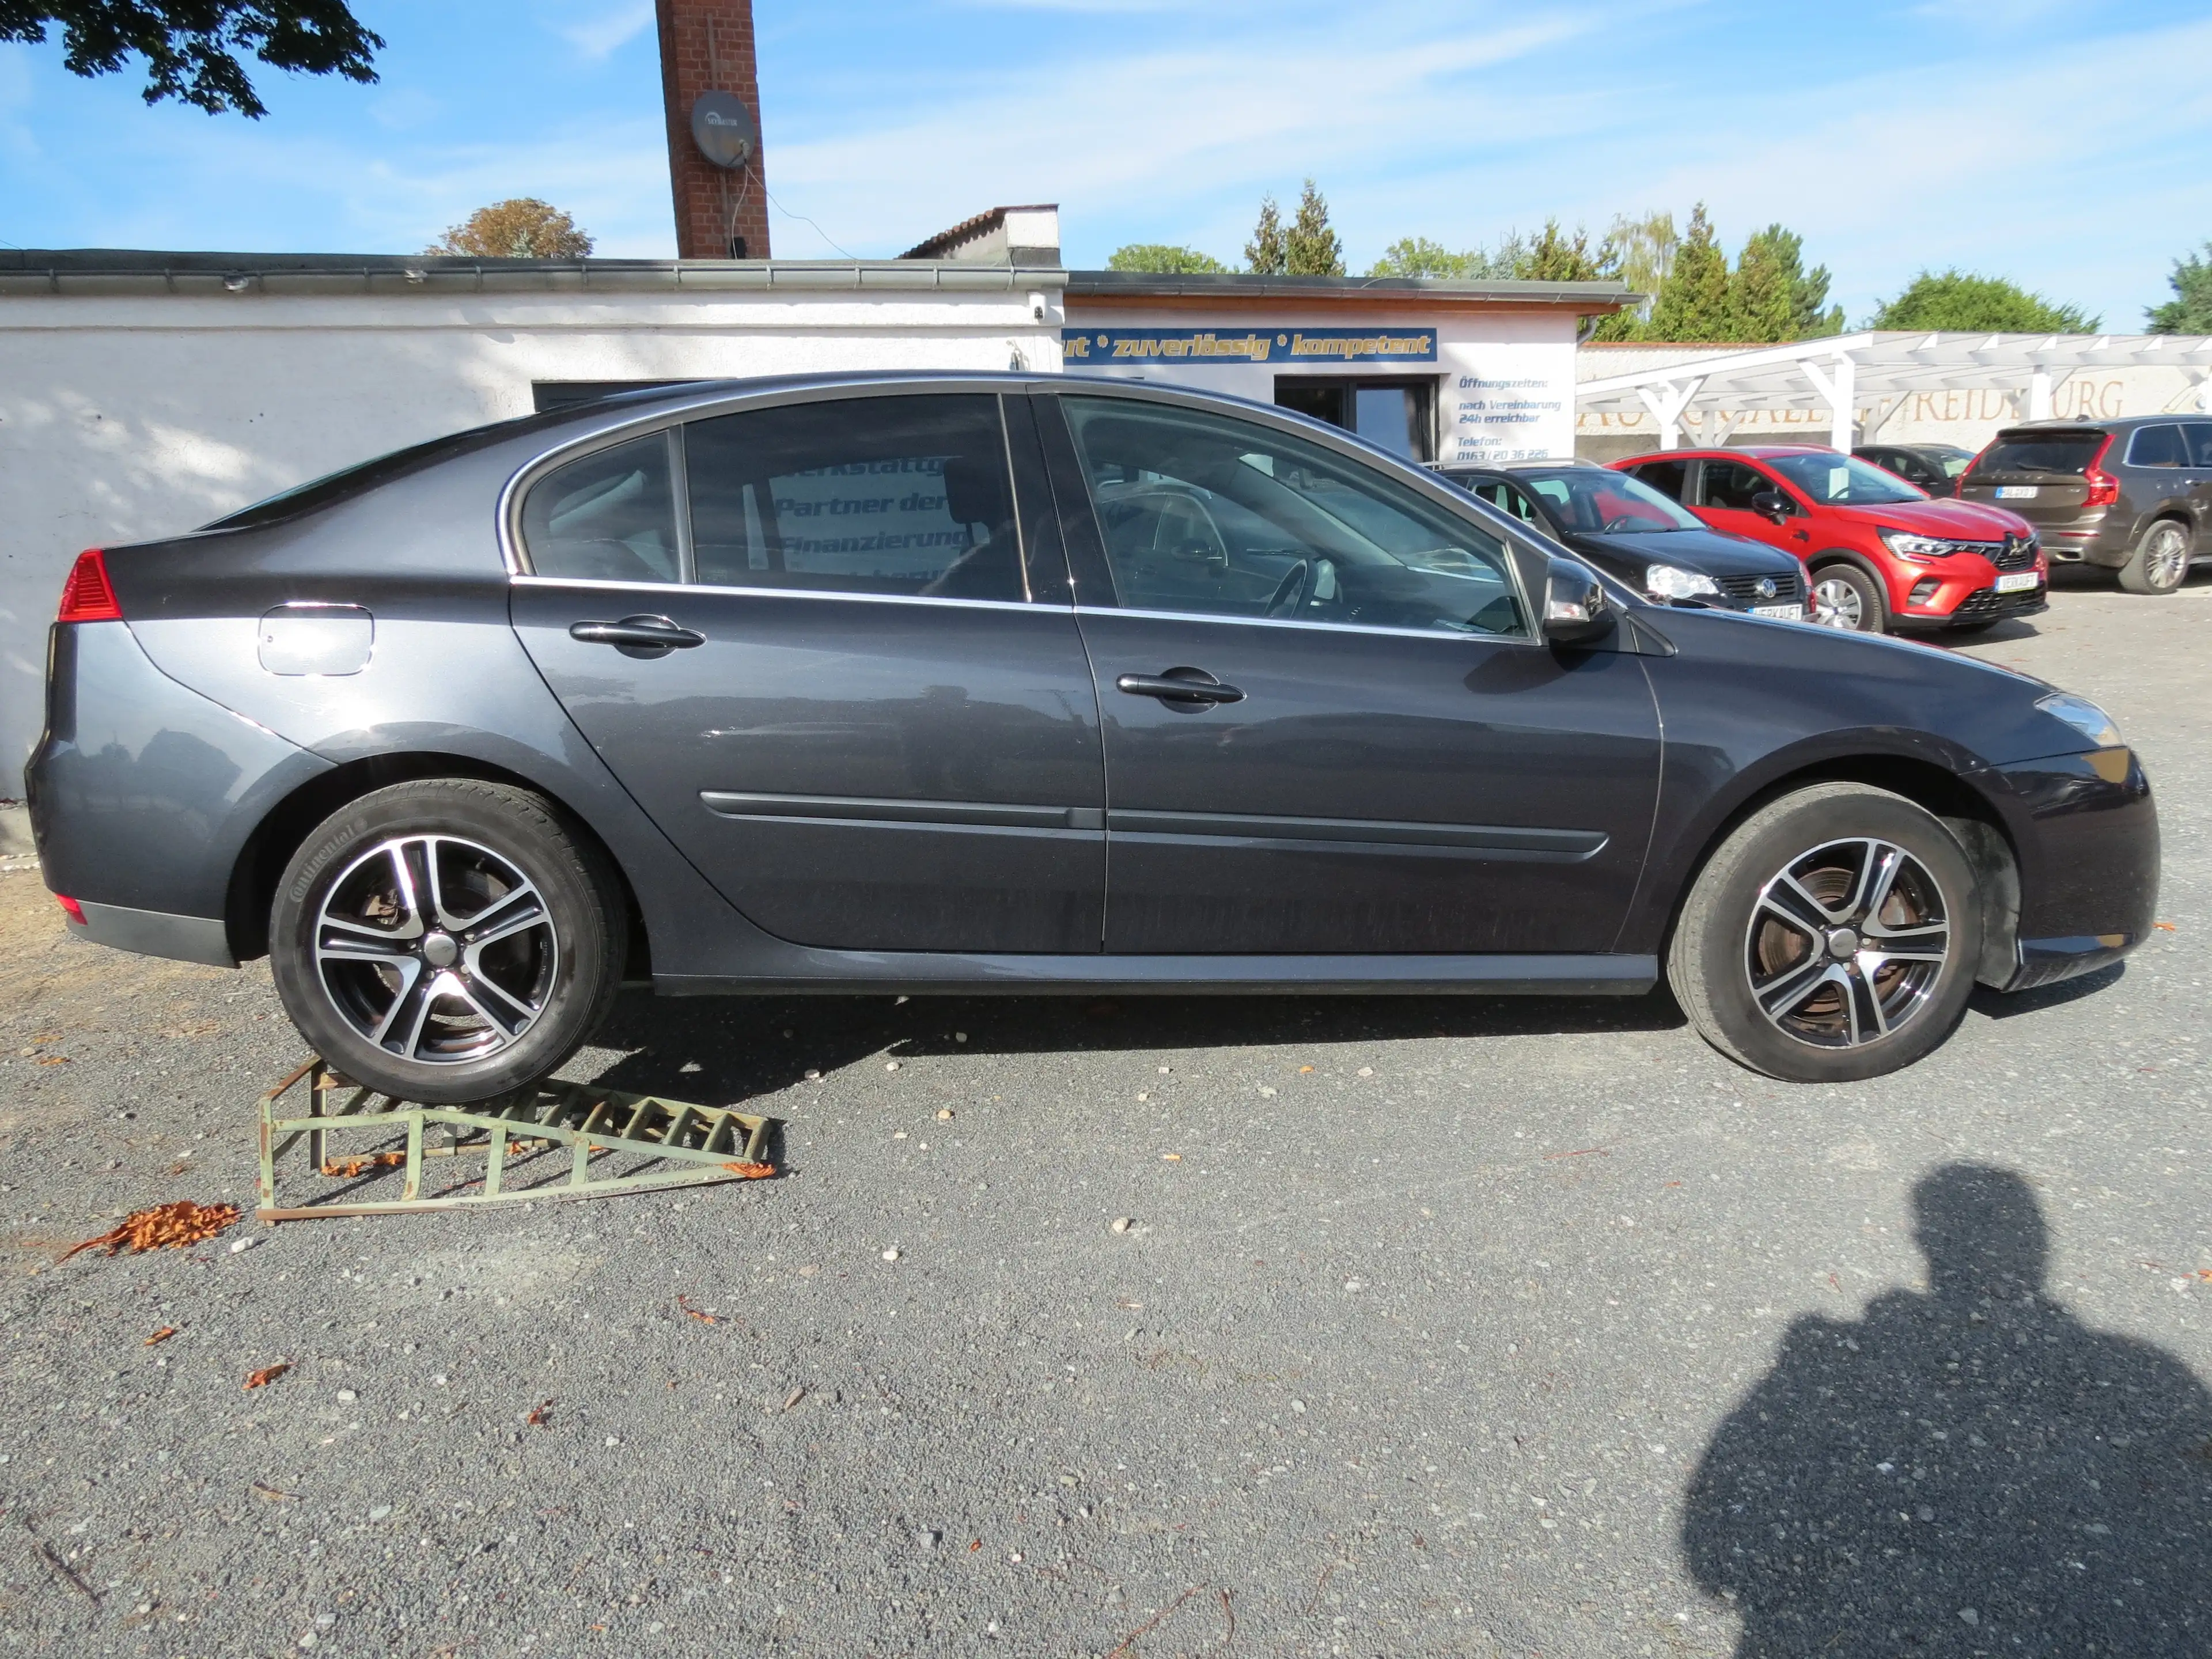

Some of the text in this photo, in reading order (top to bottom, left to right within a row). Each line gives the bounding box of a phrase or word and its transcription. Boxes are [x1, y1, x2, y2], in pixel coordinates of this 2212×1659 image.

[1063, 333, 1432, 361] ut zuverlässig kompetent
[1459, 376, 1548, 391] Öffnungszeiten:
[1459, 400, 1562, 411] nach Vereinbarung
[1459, 412, 1540, 424] 24h erreichbar
[1457, 436, 1502, 447] Telefon:
[1456, 451, 1485, 461] 0163
[1510, 449, 1525, 460] 36
[776, 497, 895, 518] Partner
